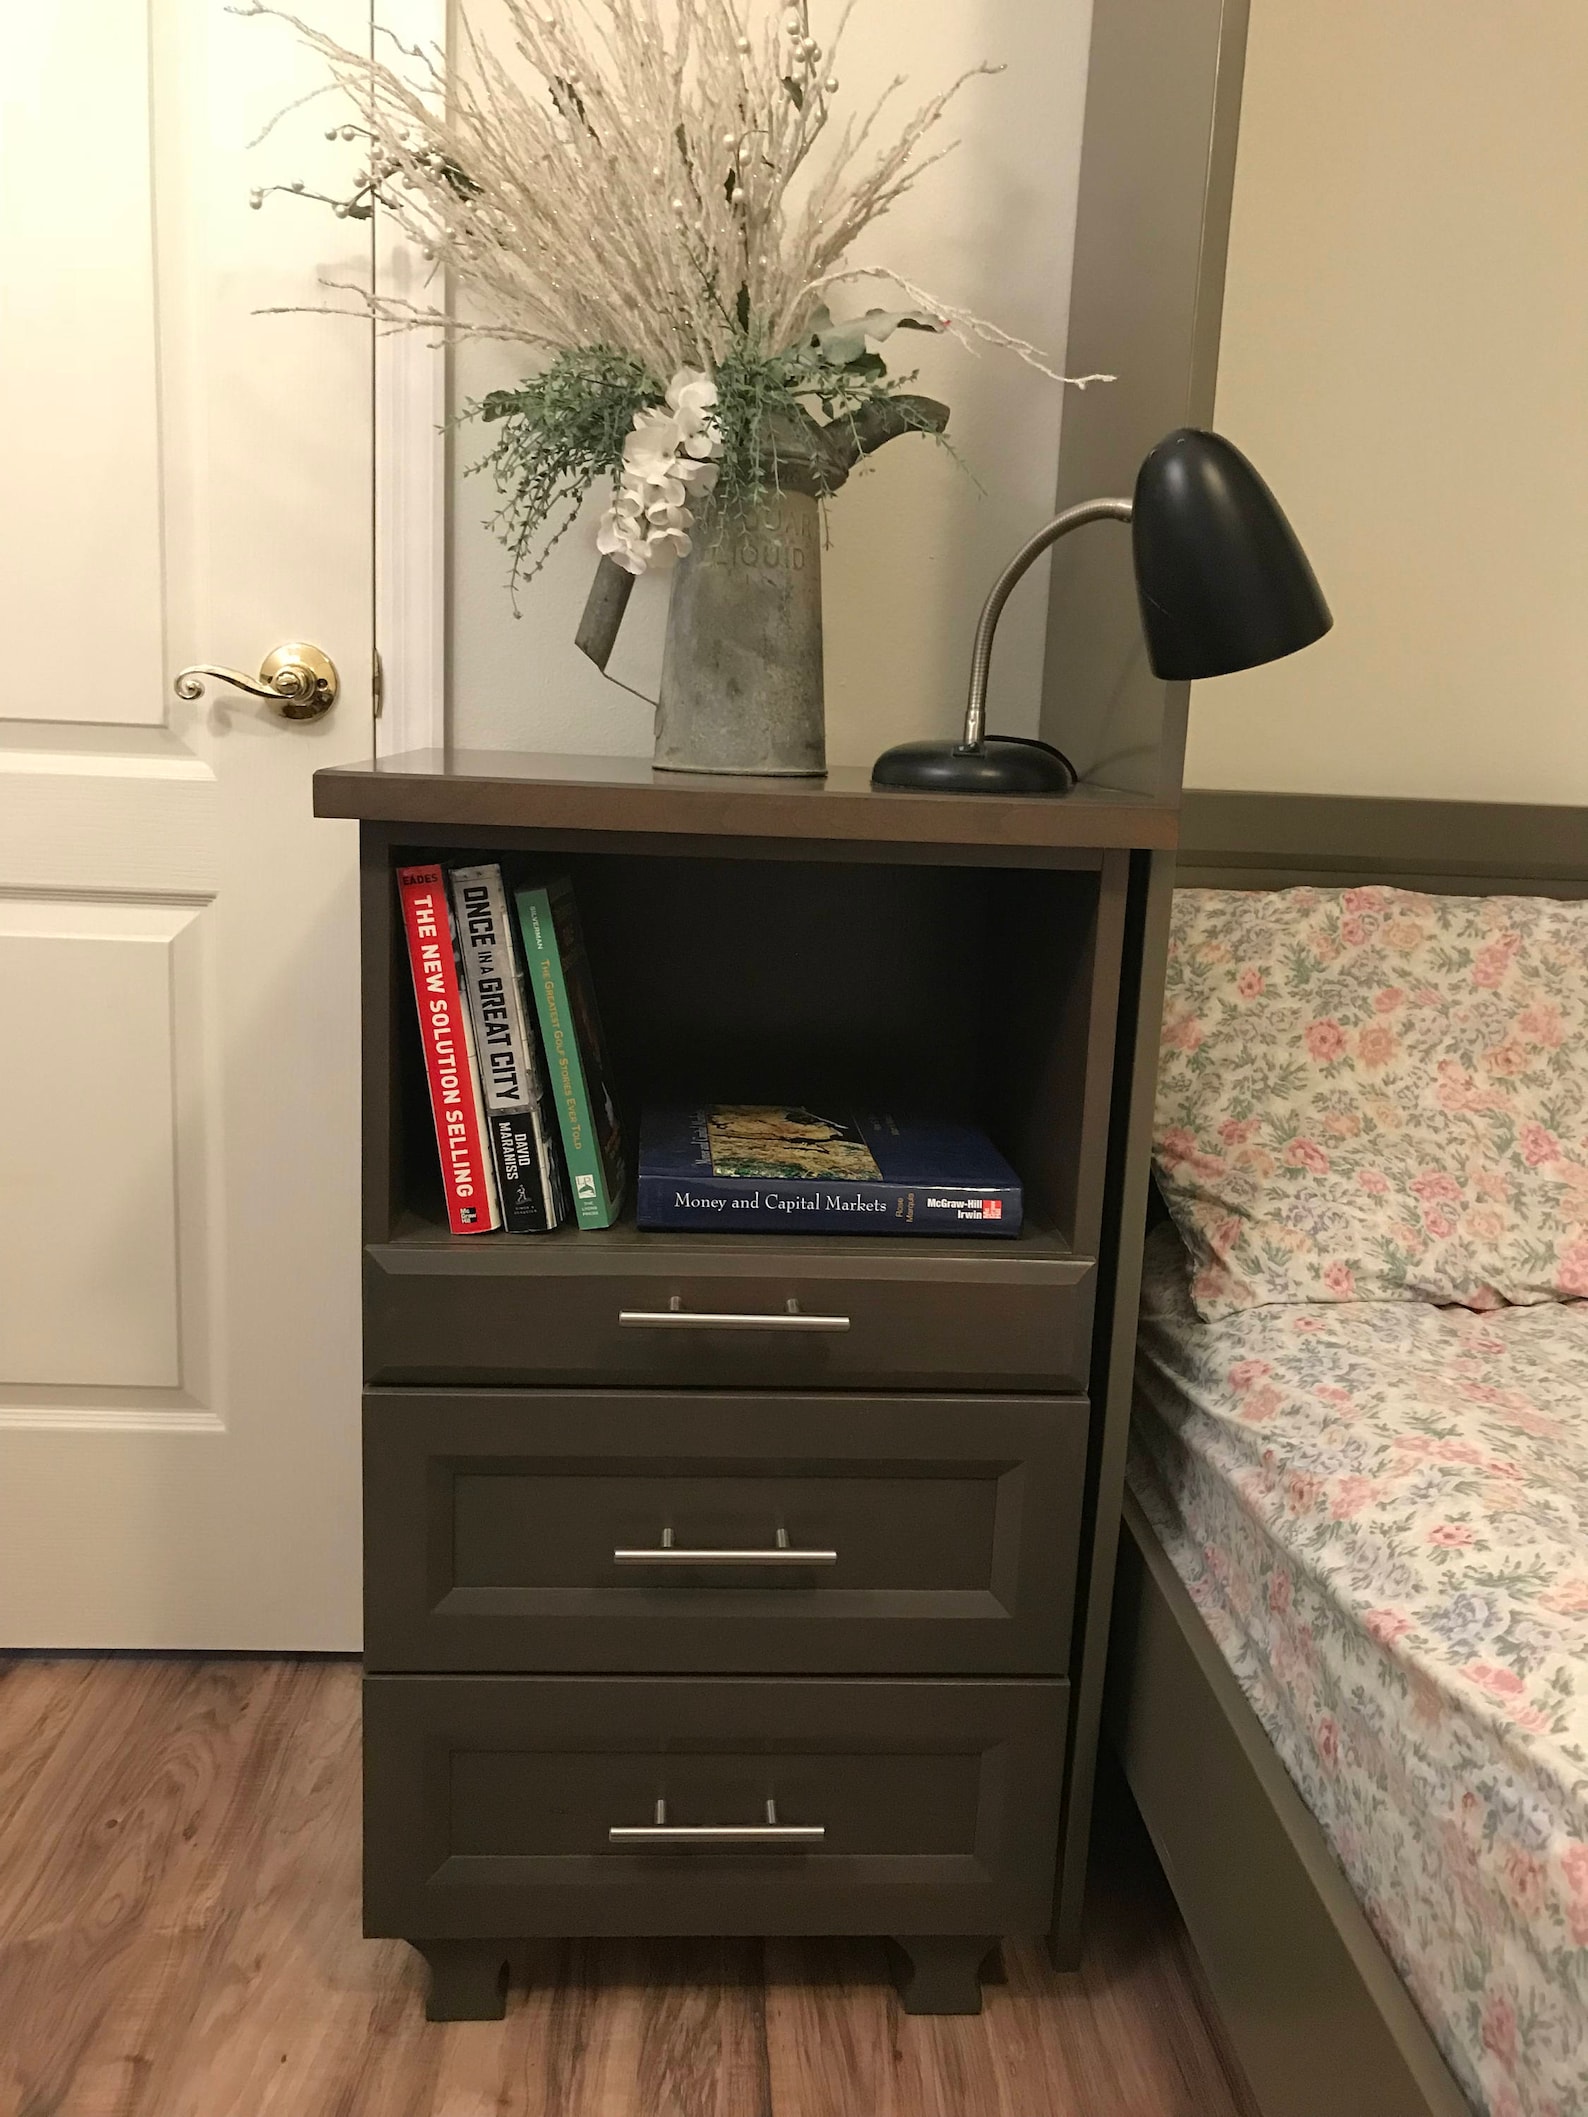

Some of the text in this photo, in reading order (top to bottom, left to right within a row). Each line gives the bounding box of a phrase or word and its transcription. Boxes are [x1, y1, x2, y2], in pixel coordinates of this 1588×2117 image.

[711, 545, 806, 571] LIQUID
[402, 873, 439, 886] EADES
[529, 906, 544, 950] SILVERMAN
[463, 886, 520, 1100] ONCE IN A GREAT CITY
[414, 894, 474, 1197] THE NEW SOLUTION SELLING
[541, 960, 583, 1150] THE GREATEST GOLF STORIES EVER TOLD
[499, 1122, 519, 1180] MARANISS
[514, 1133, 530, 1166] DAVID
[674, 1192, 887, 1213] Money and Capital Markets
[927, 1198, 982, 1209] McGraw-Hill
[957, 1210, 982, 1219] Irwin
